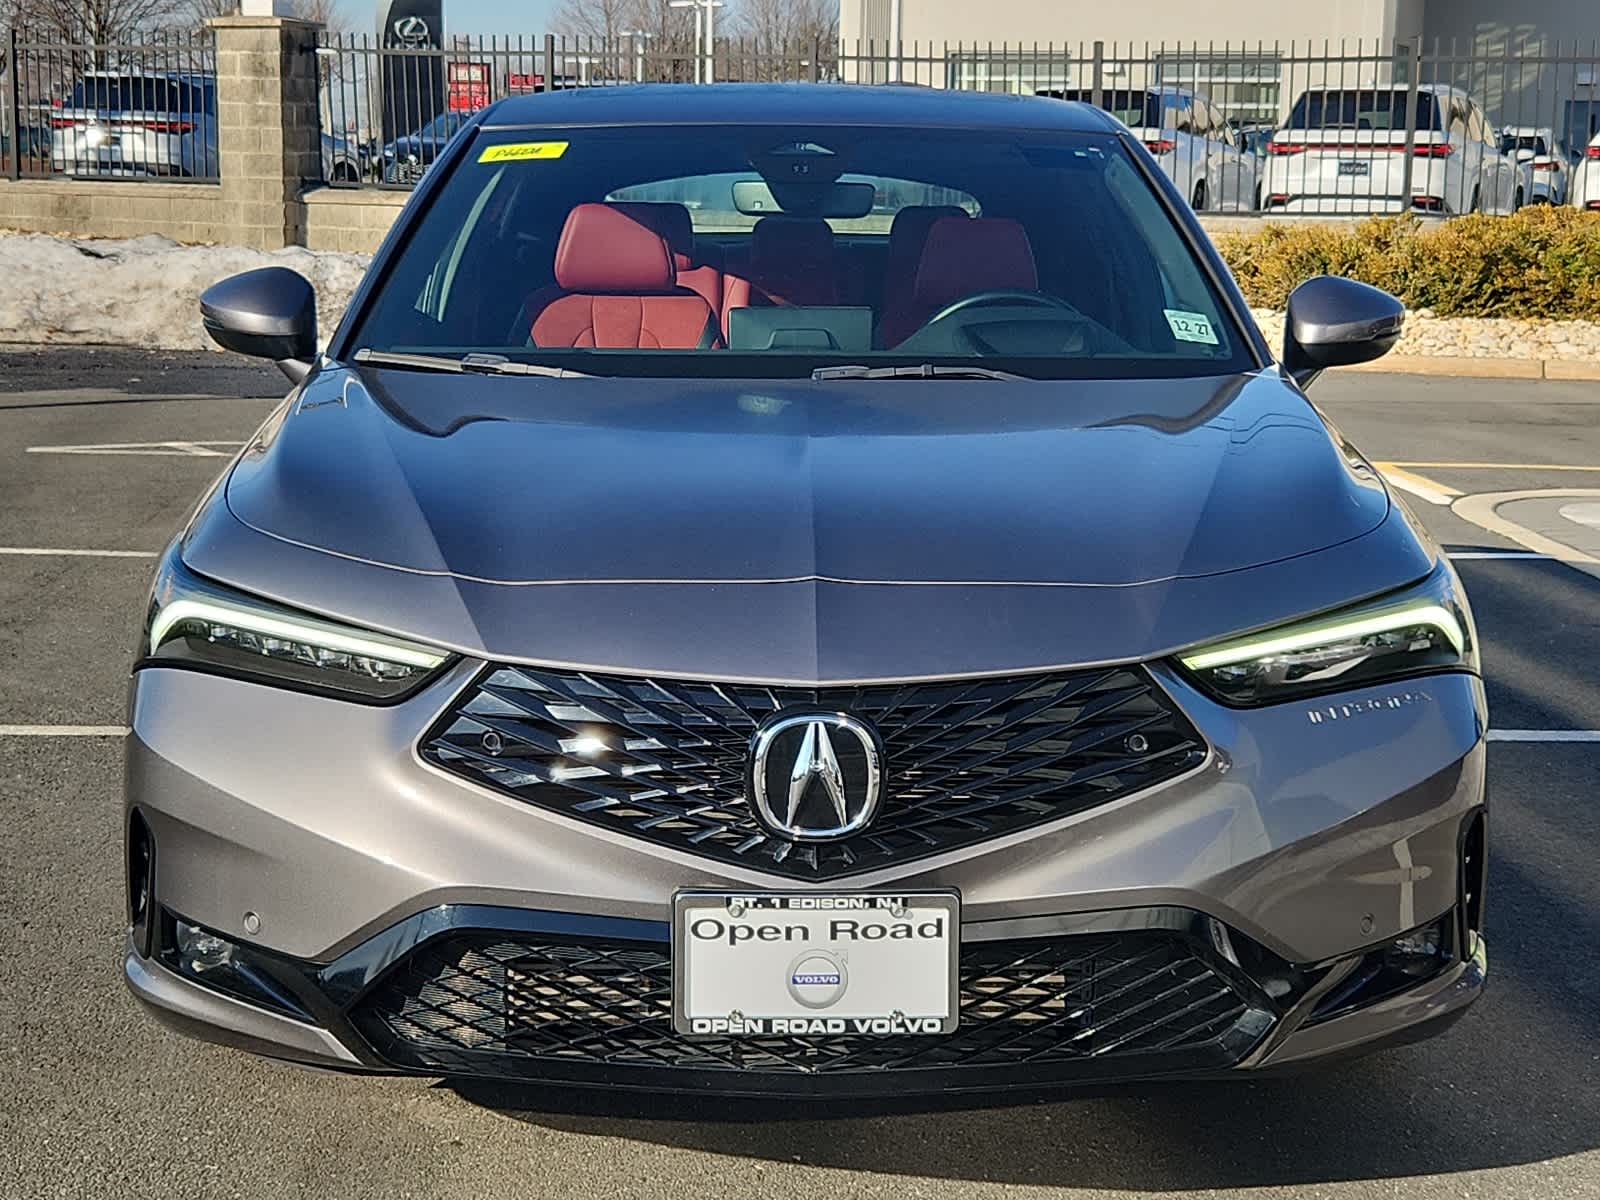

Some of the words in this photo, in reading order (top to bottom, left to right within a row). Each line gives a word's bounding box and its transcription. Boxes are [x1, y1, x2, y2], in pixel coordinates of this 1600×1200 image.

[1173, 319, 1192, 333] 12
[1194, 322, 1209, 336] 27
[731, 897, 762, 908] RT.
[770, 897, 781, 908] 1
[788, 897, 870, 909] EDISON,
[690, 918, 810, 945] Open
[829, 917, 944, 941] Road
[794, 975, 840, 984] VOLVO
[691, 1018, 763, 1034] OPEN
[771, 1018, 846, 1034] ROAD
[852, 1018, 943, 1034] VOLVO
